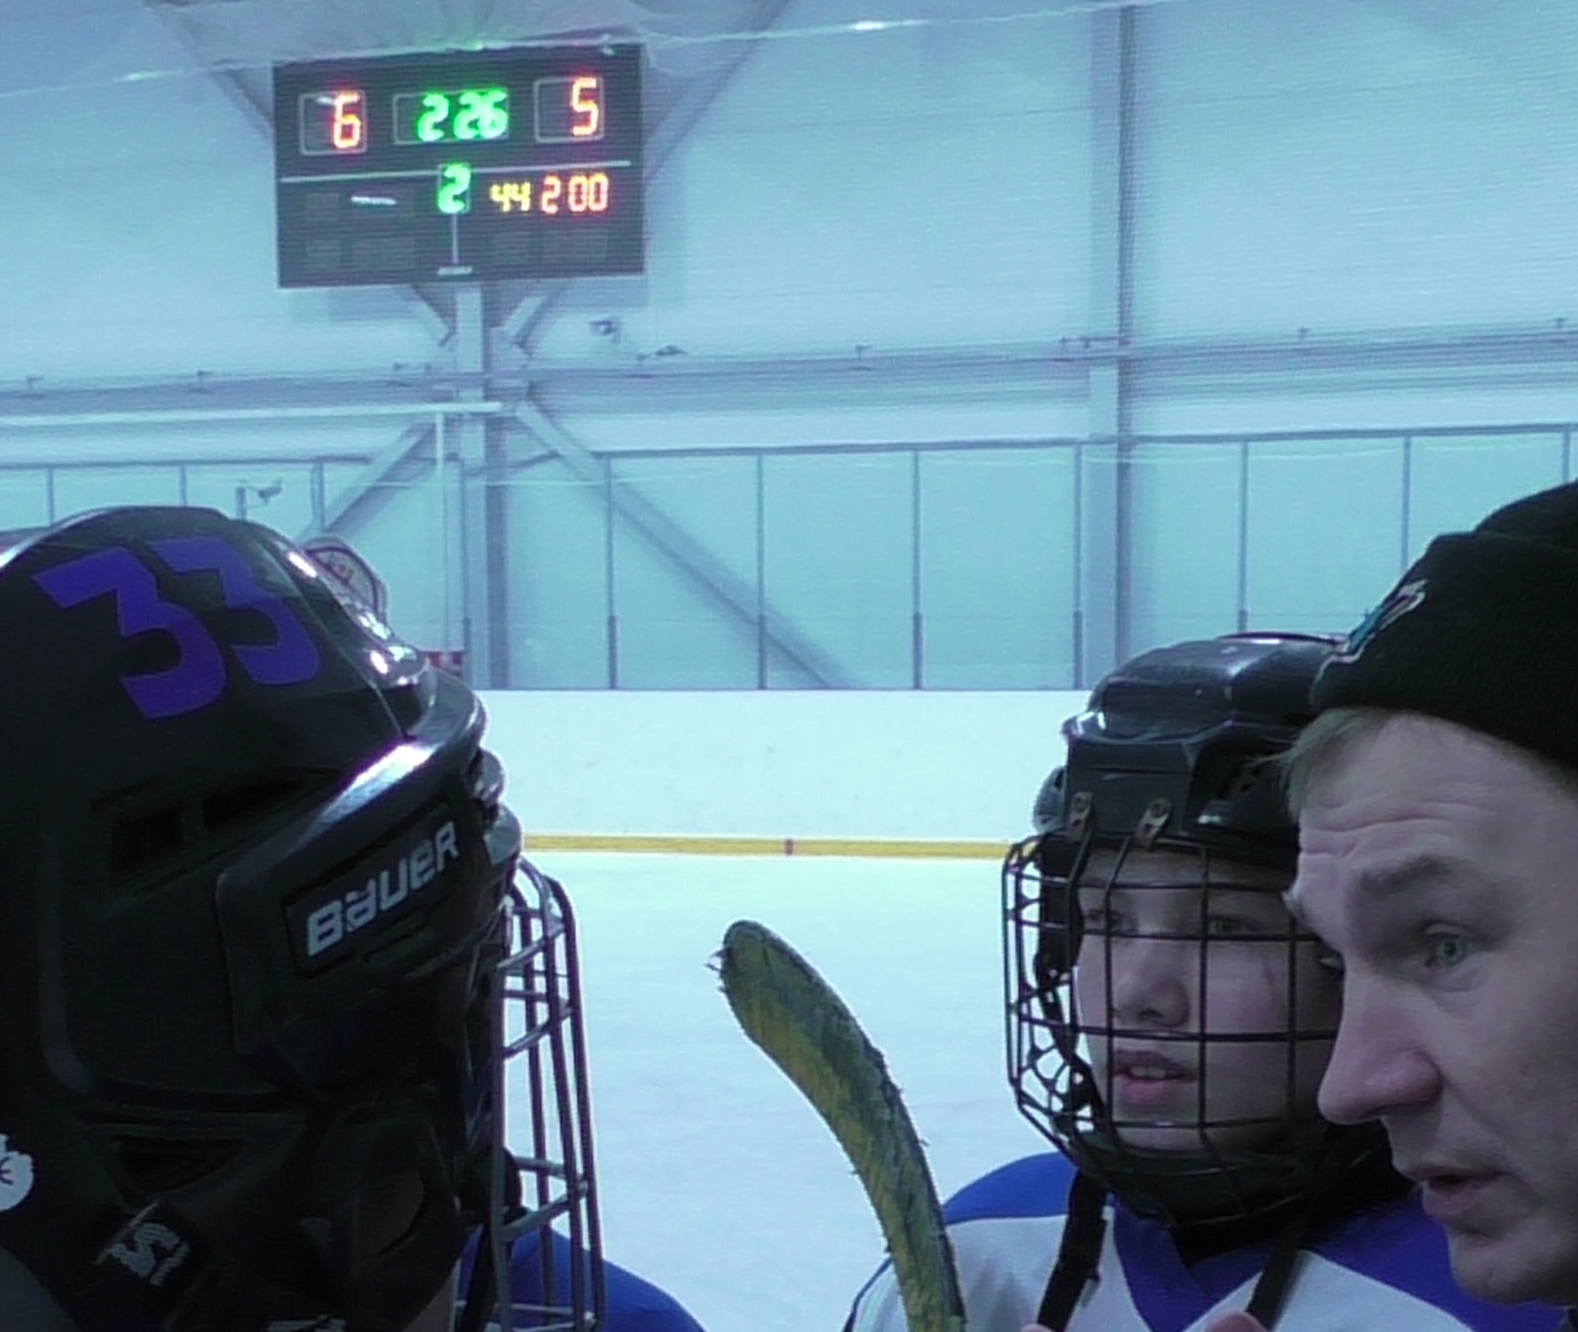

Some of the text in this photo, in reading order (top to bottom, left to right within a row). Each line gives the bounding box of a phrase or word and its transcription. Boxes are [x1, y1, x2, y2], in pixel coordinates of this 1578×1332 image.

[332, 89, 361, 148] 6
[571, 76, 600, 137] 5
[438, 163, 471, 214] 2
[490, 181, 531, 212] 44
[32, 537, 323, 720] 33
[305, 818, 459, 956] BAUER
